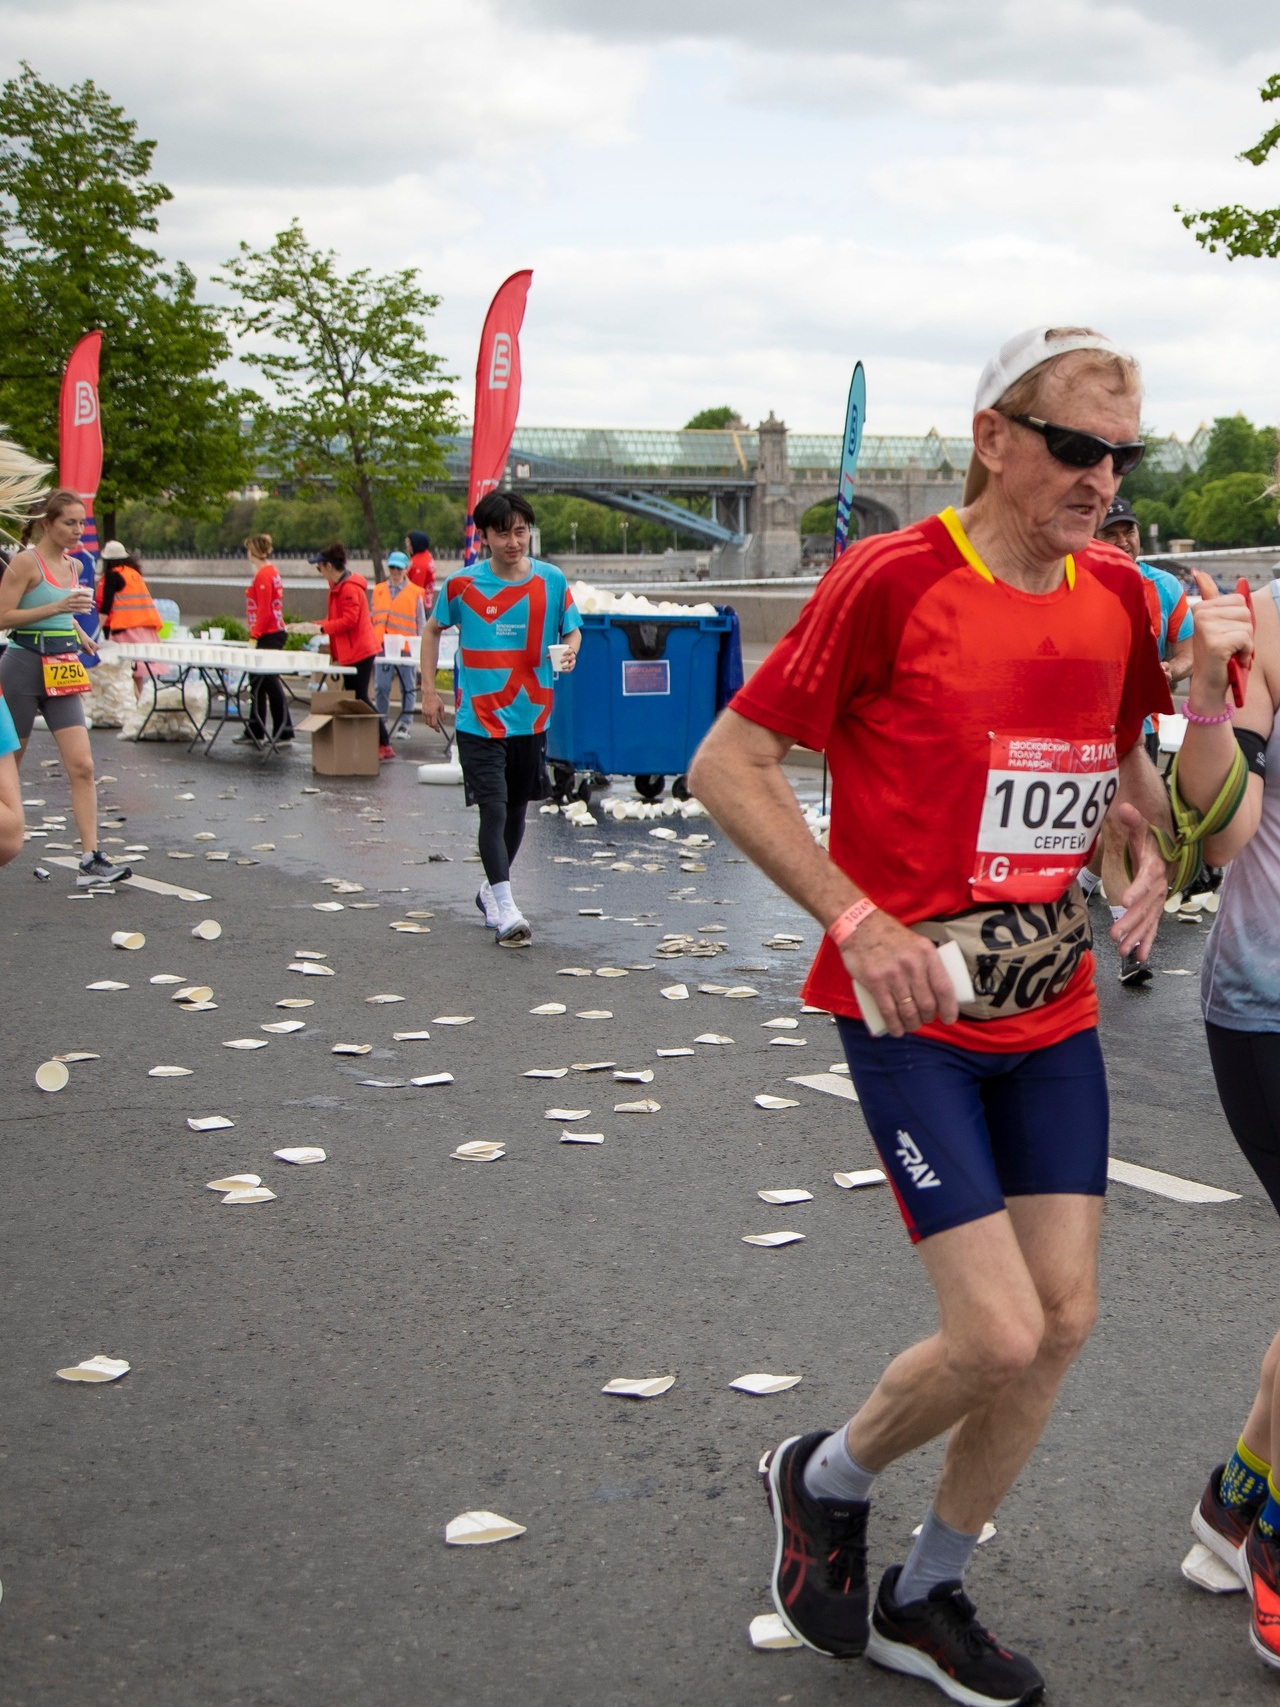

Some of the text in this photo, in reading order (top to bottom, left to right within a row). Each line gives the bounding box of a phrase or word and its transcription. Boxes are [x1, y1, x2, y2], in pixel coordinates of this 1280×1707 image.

[1008, 758, 1054, 768] МАРАФОН
[995, 777, 1118, 829] 10269
[1034, 833, 1087, 850] СЕРГЕЙ
[989, 856, 1011, 883] G
